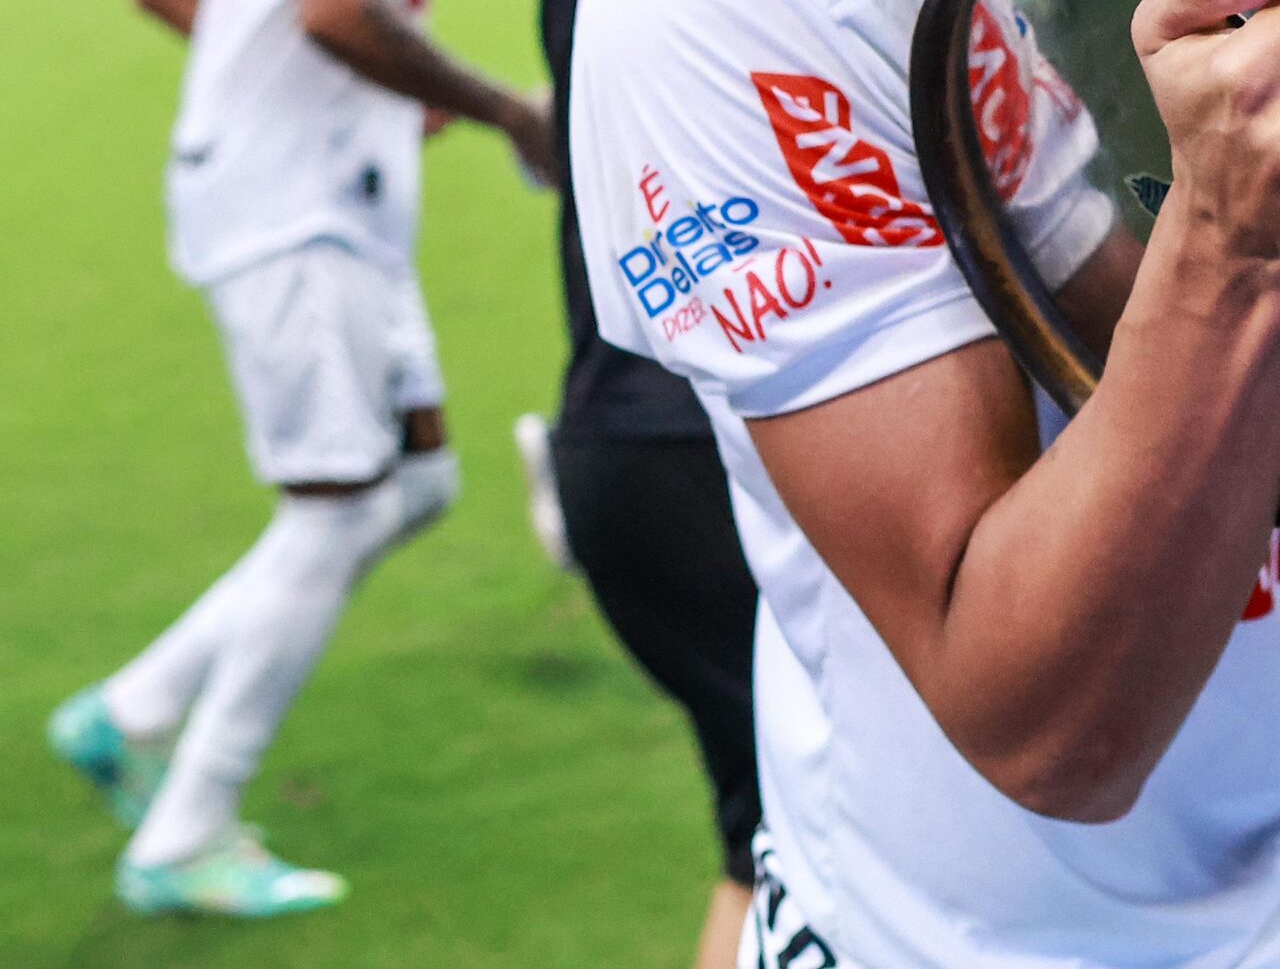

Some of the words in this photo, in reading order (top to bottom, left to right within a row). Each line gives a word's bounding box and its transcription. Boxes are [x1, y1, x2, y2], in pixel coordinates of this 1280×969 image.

[639, 164, 670, 223] É
[637, 231, 760, 319] Delas
[710, 234, 834, 353] NÃO!
